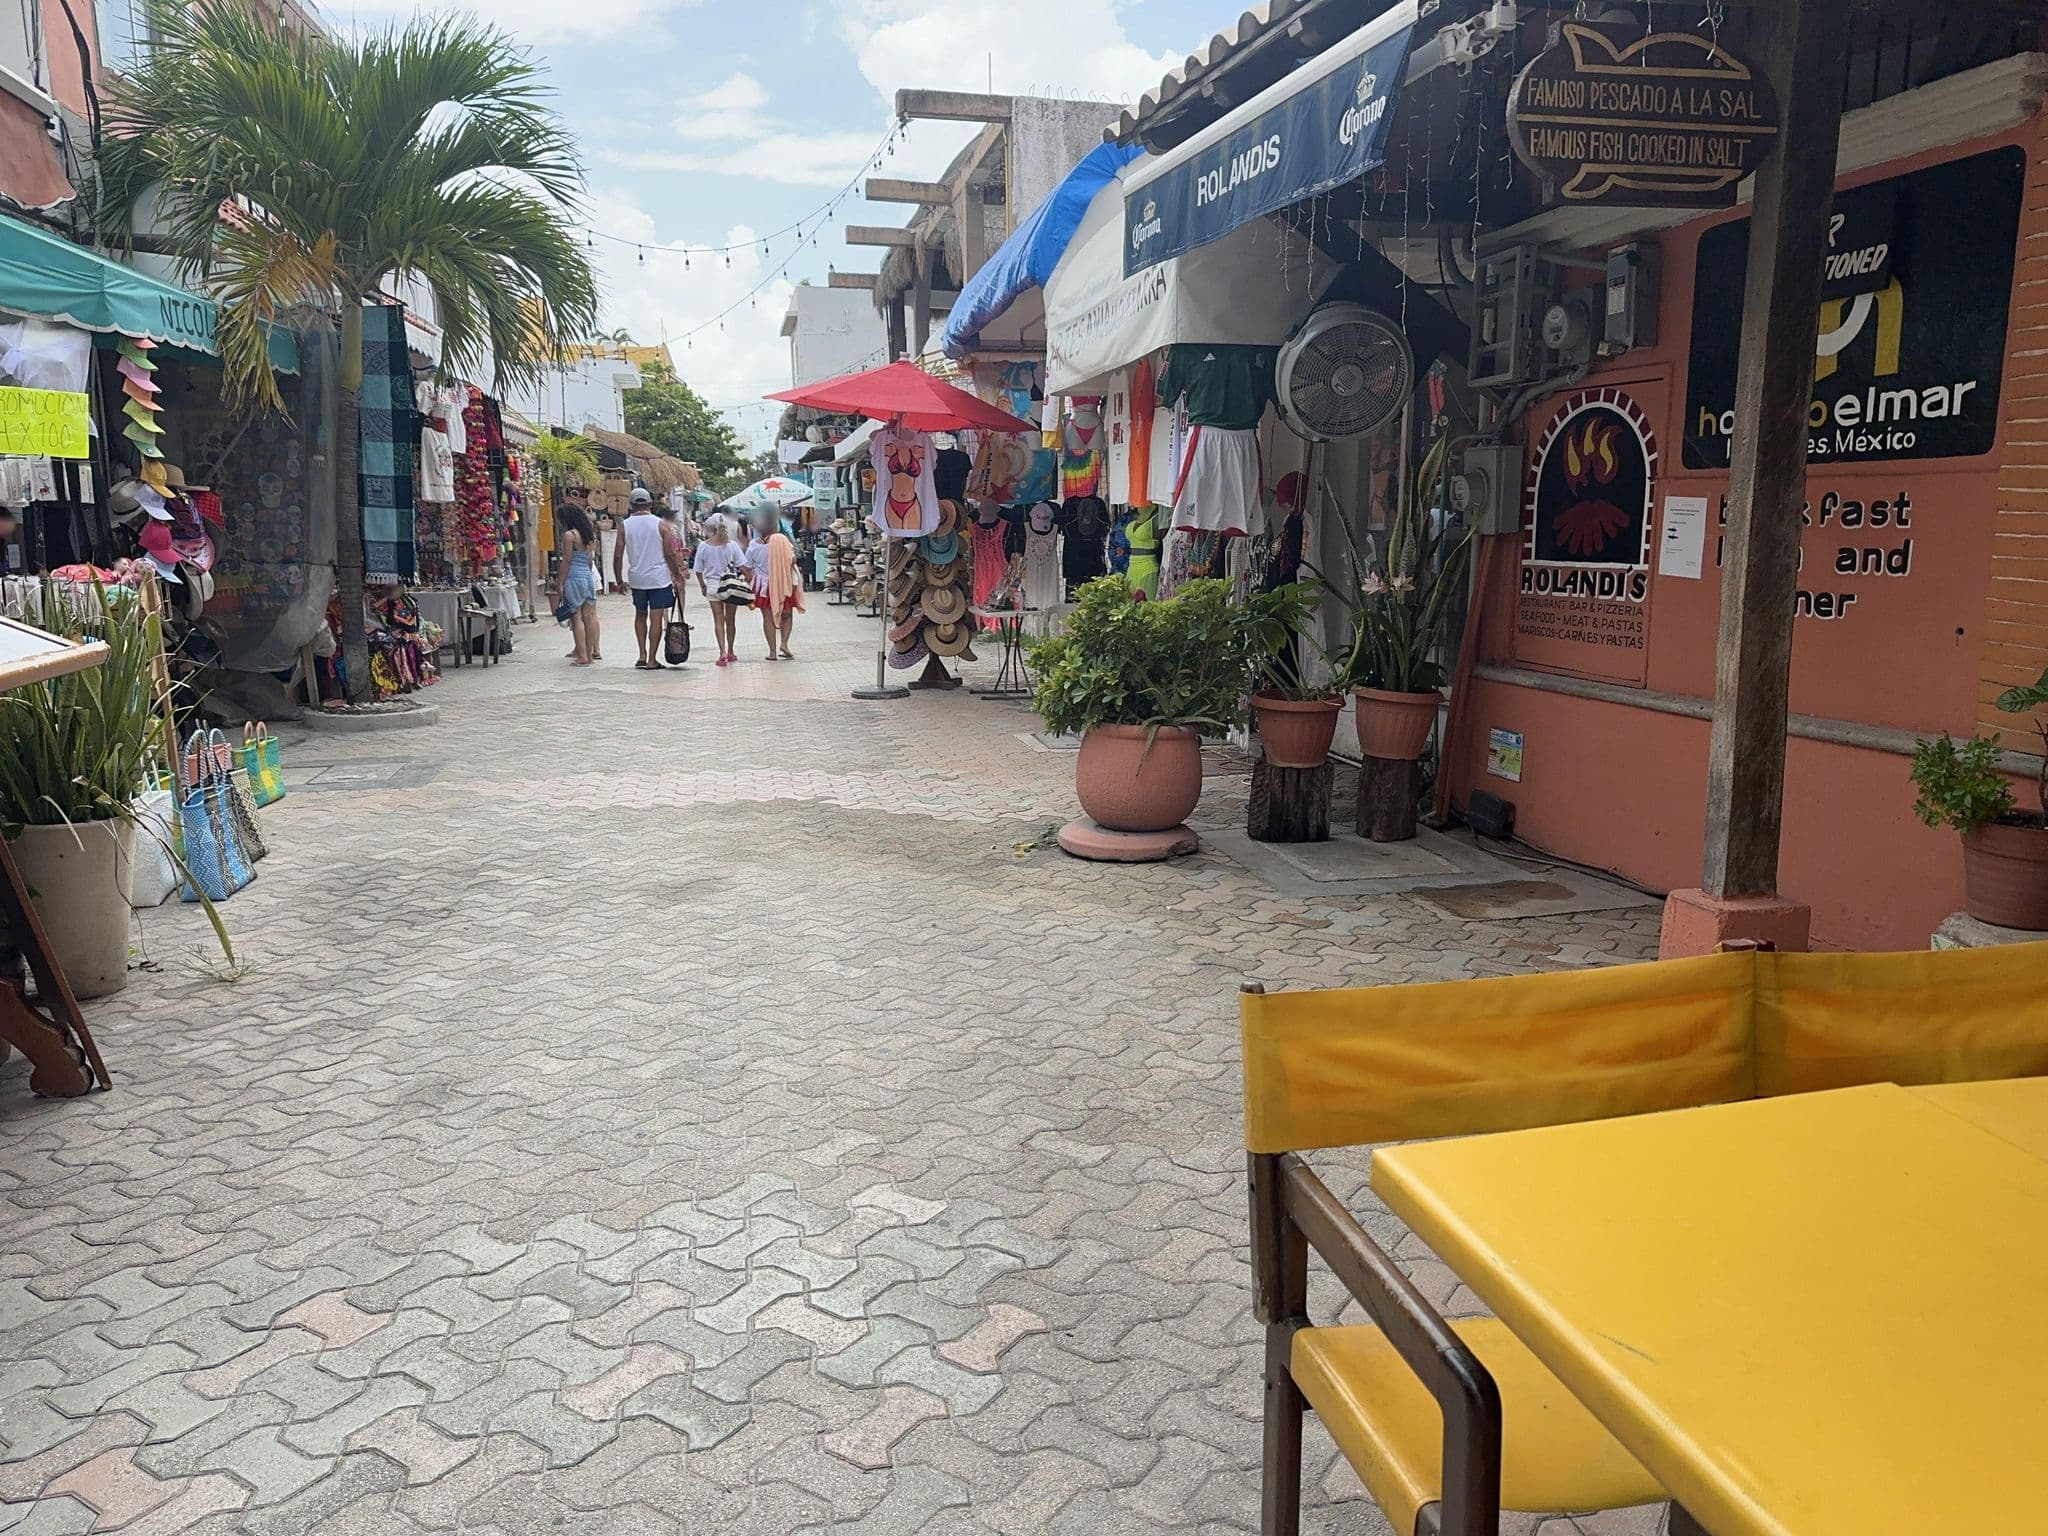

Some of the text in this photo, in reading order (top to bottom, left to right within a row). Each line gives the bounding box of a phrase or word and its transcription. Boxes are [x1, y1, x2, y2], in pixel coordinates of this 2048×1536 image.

[1526, 78, 1763, 119] FAMOSO PESCADO A LA SAL
[1340, 95, 1386, 146] Corona
[1530, 128, 1752, 168] FAMOUS FISH COOKED IN SALT
[1197, 134, 1281, 207] ROLANDIS
[1825, 243, 1889, 280] TIONED
[159, 294, 215, 340] NICOL
[39, 420, 71, 449] 100
[1835, 426, 1917, 454] México
[1835, 539, 1913, 576] and
[1520, 565, 1648, 603] ROLANDI'S
[1569, 600, 1588, 612] BAR
[1597, 602, 1644, 617] PIZZERIA
[1795, 590, 1857, 619] ner
[1563, 614, 1590, 627] MEAT
[1601, 618, 1643, 633] PASTAS
